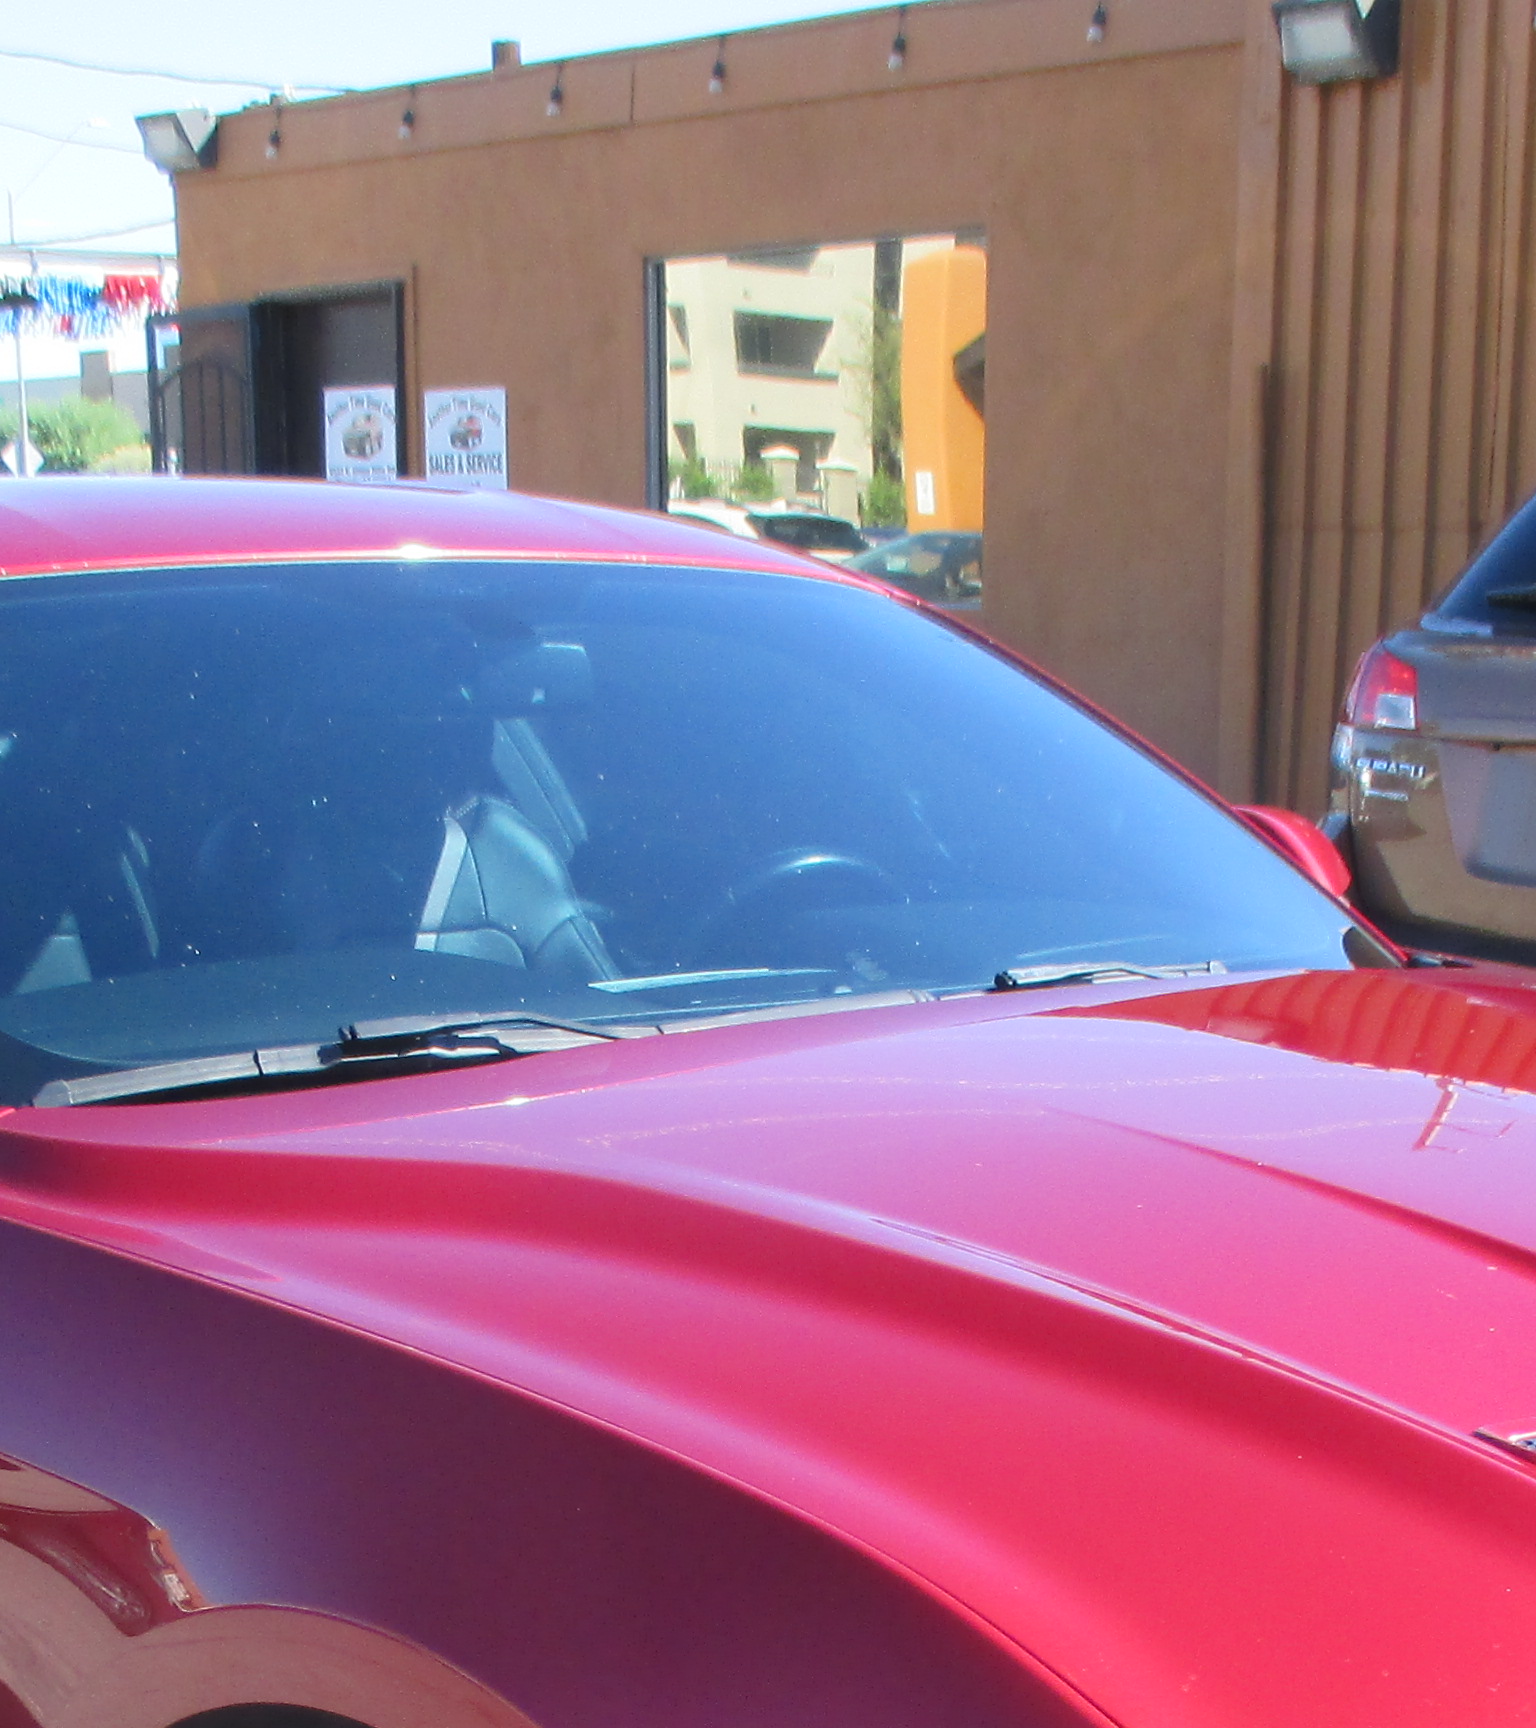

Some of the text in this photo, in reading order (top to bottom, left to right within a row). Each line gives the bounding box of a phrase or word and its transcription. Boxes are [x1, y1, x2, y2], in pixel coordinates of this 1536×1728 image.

[429, 454, 455, 475] SALES
[466, 453, 503, 475] SERVICE
[1356, 757, 1425, 778] SUBARU
